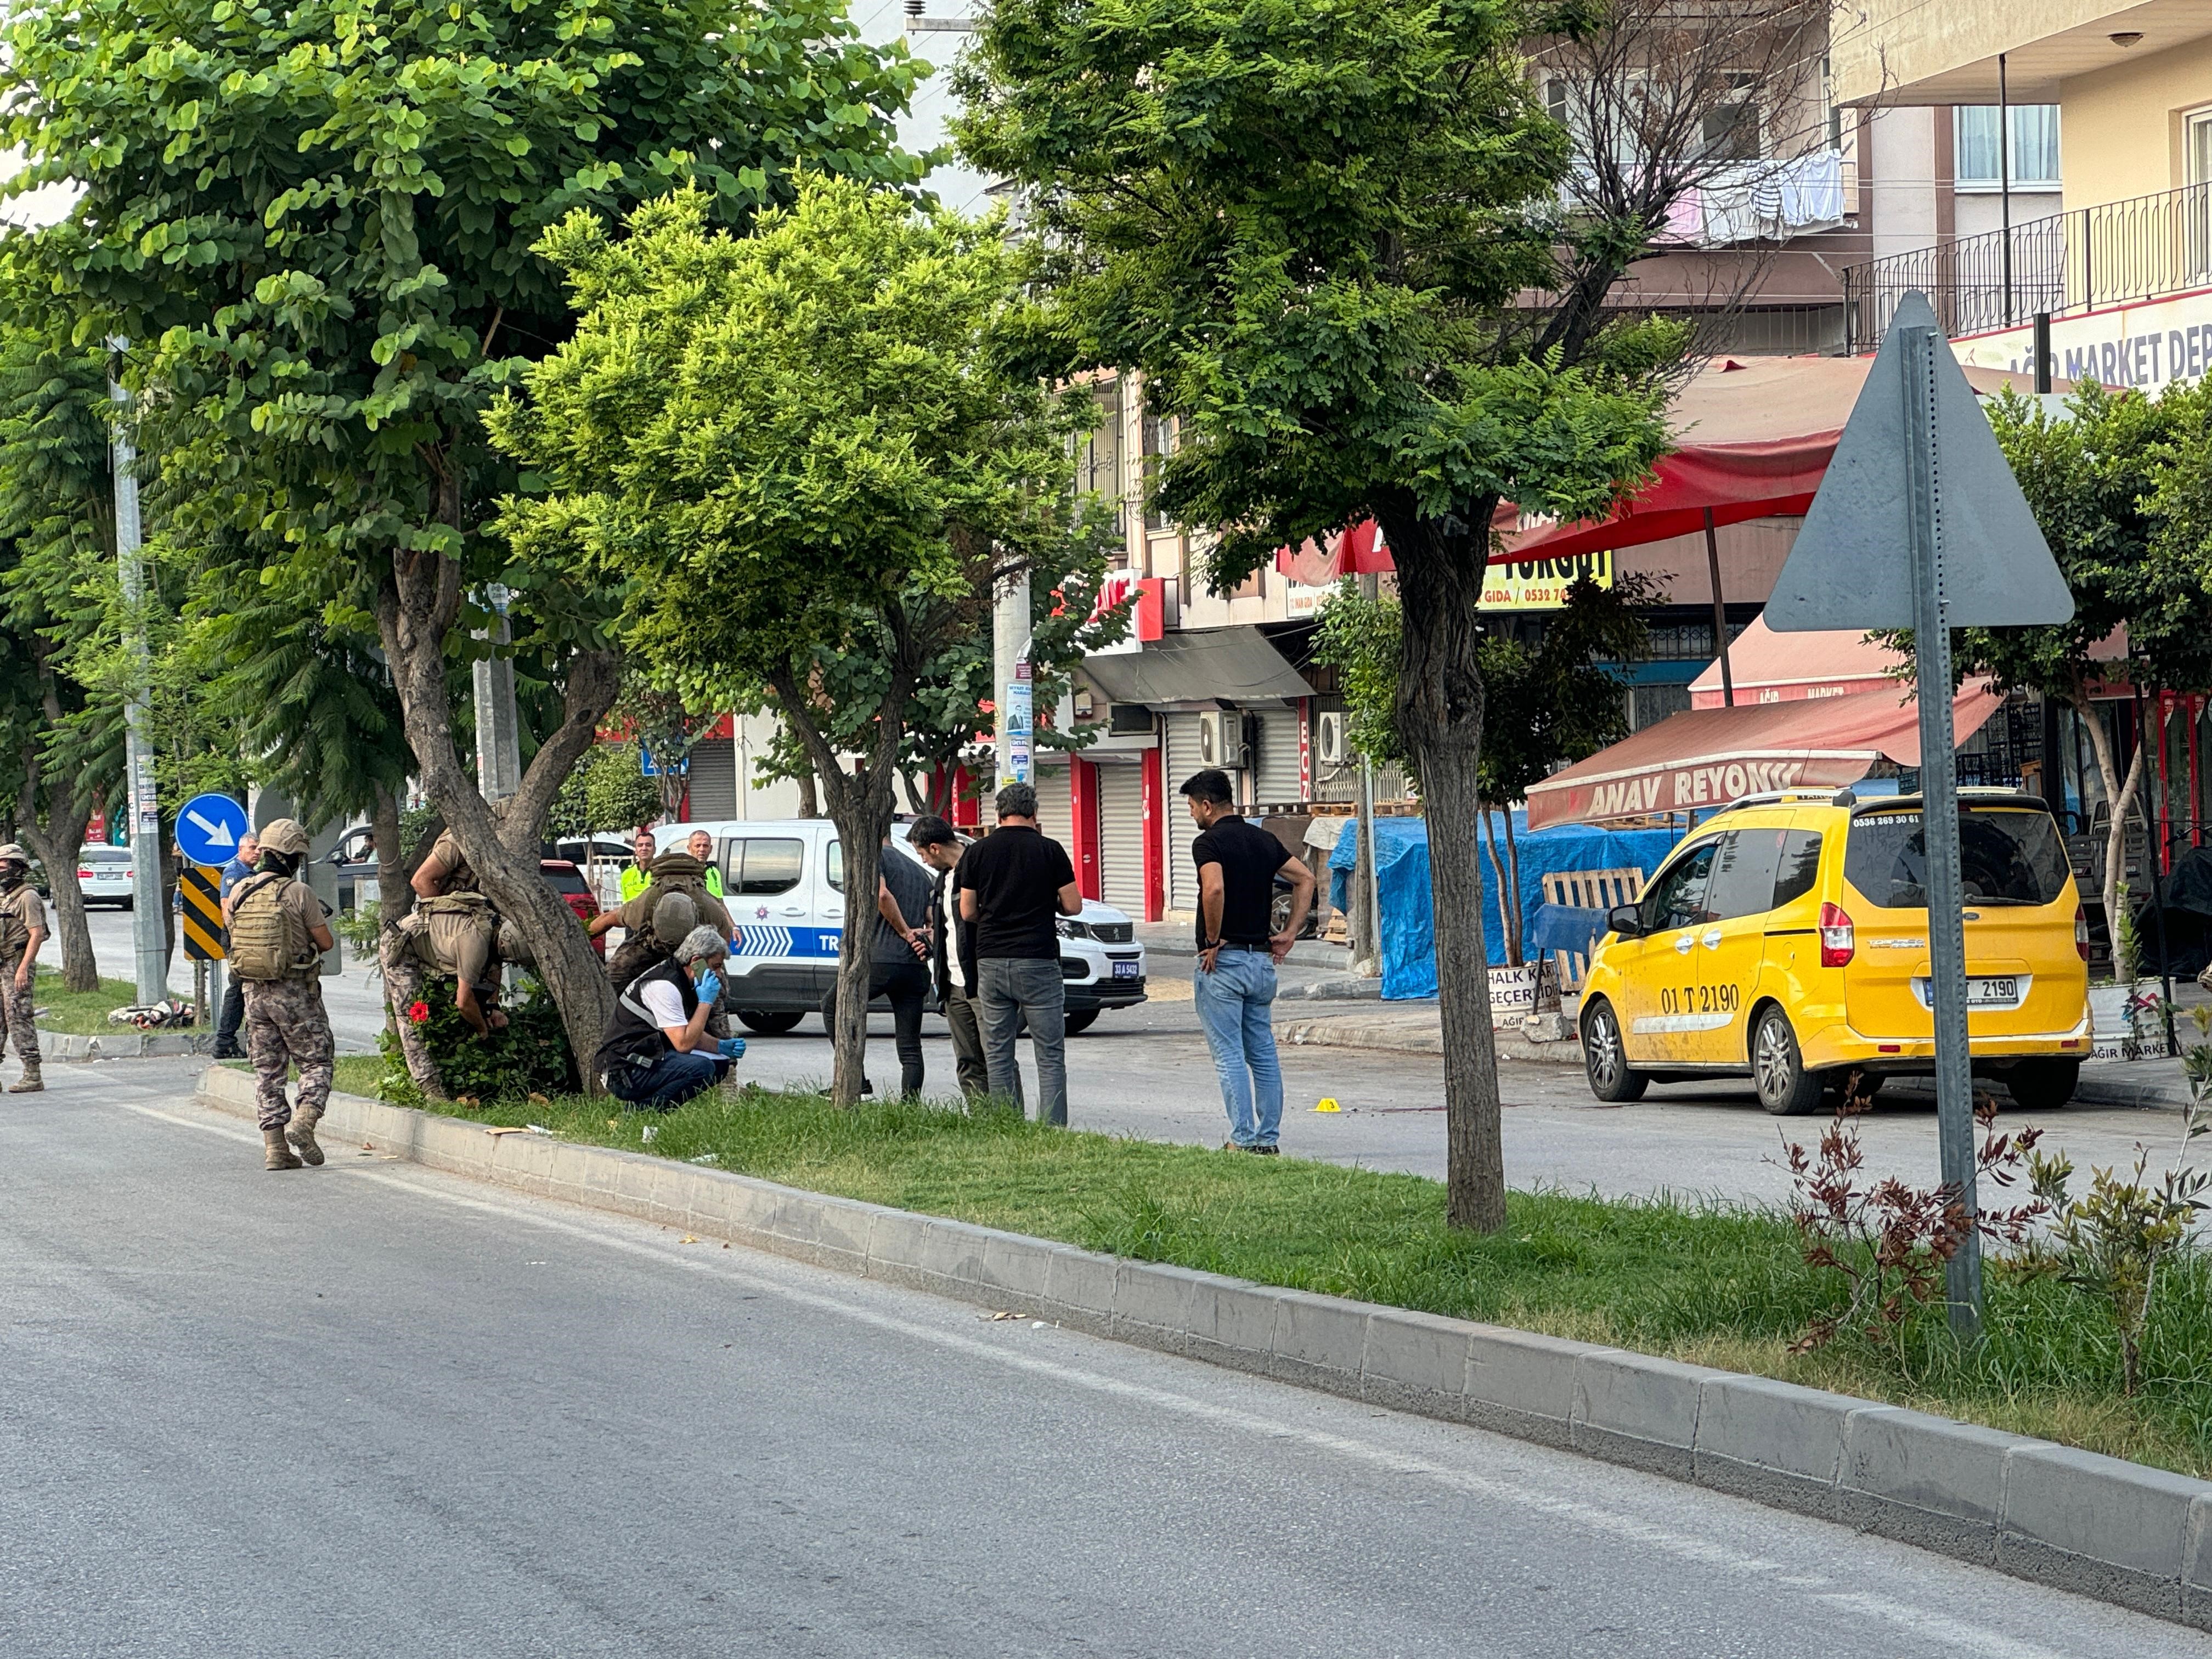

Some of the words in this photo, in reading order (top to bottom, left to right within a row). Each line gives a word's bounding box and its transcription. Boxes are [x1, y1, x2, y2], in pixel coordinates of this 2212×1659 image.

[2066, 332, 2162, 387] MARKET
[1485, 590, 1511, 603] GIDA
[1525, 589, 1550, 602] 0532
[1877, 816, 1894, 825] 269
[1896, 815, 1907, 824] 30
[1909, 815, 1919, 823] 61
[1488, 970, 1523, 985] HALK
[1489, 983, 1558, 1006] GEÇERİDİ
[1982, 980, 2015, 997] 2190
[1662, 988, 1679, 1014] 01
[1684, 987, 1695, 1013] T
[1700, 984, 1739, 1012] 2190
[2090, 1046, 2118, 1059] AĞIR
[2121, 1043, 2169, 1058] MARKE
